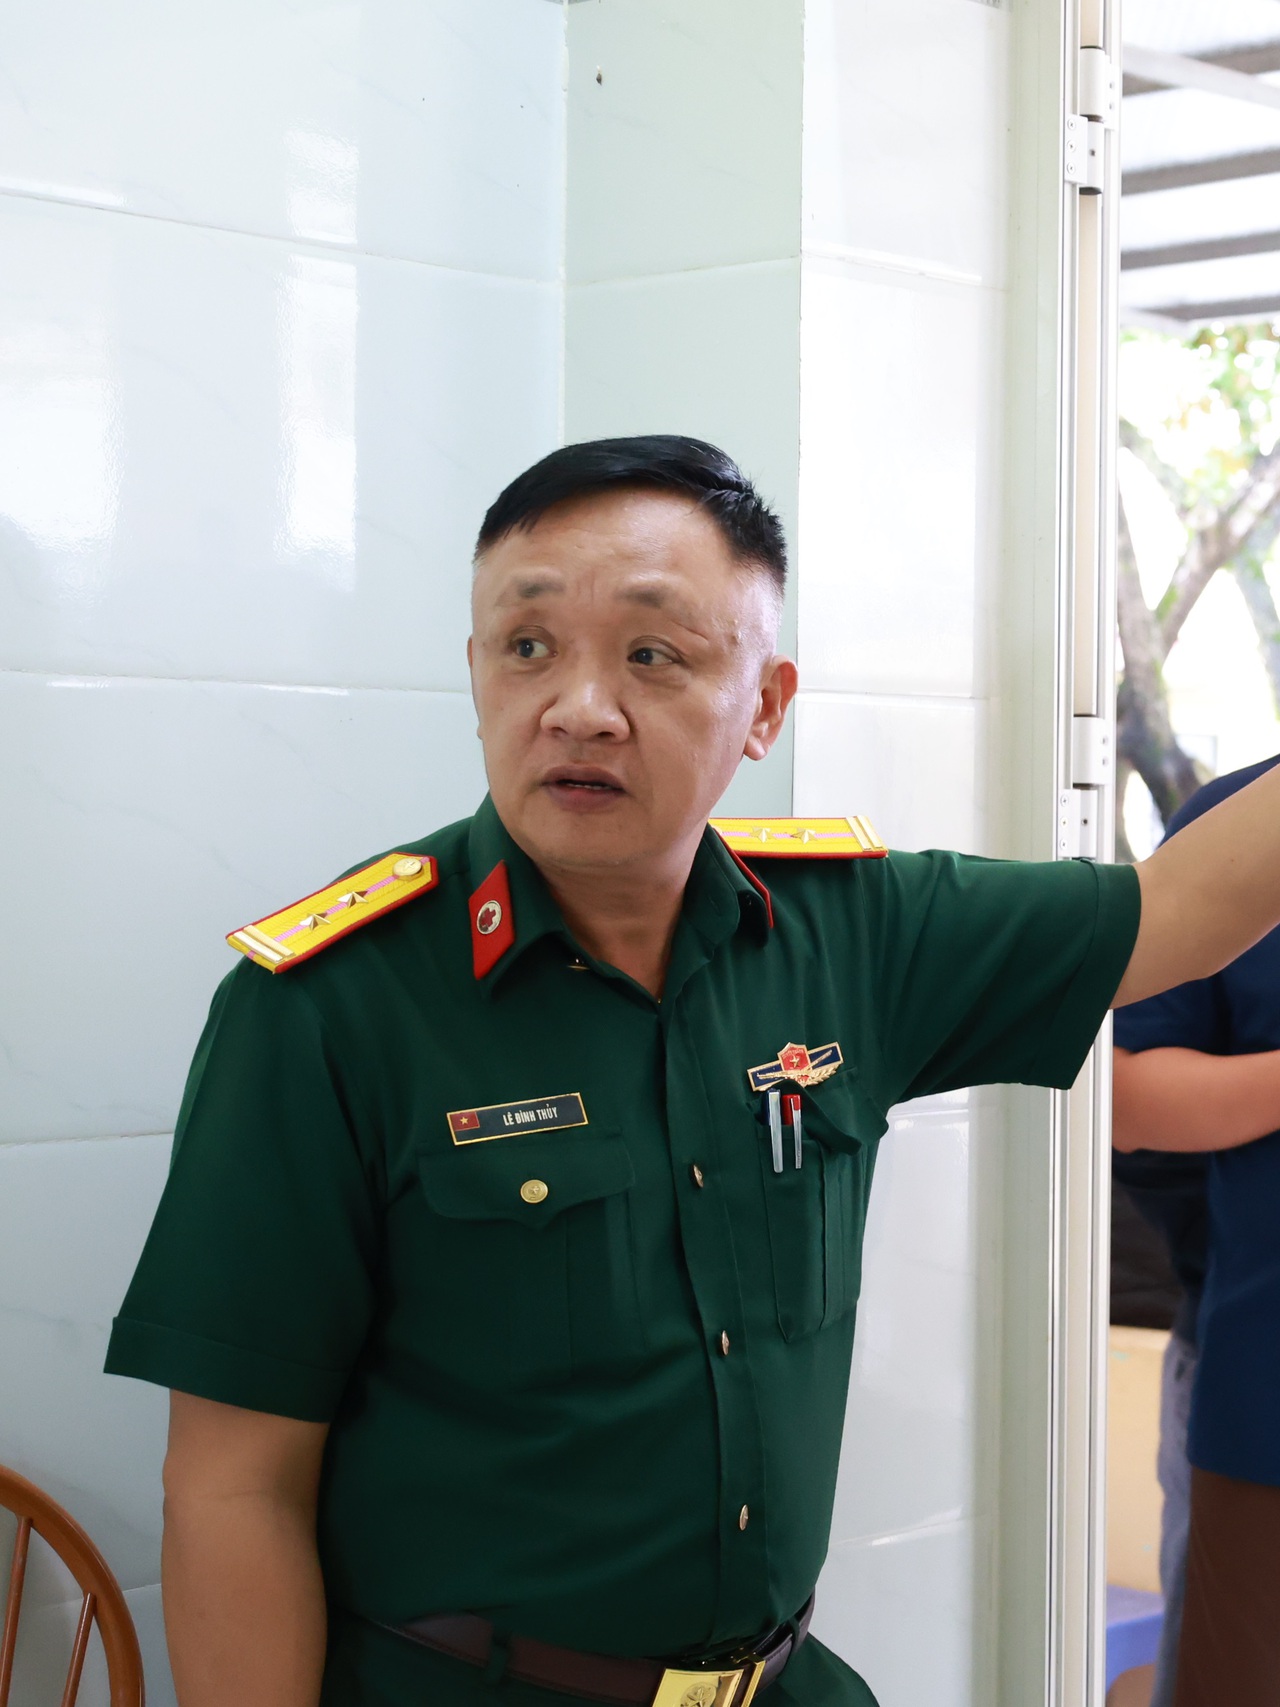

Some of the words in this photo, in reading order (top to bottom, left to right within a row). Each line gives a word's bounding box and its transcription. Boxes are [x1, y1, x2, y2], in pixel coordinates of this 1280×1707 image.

[502, 1111, 514, 1126] LÊ
[514, 1109, 536, 1125] ĐÌNH
[536, 1103, 558, 1121] THỦY
